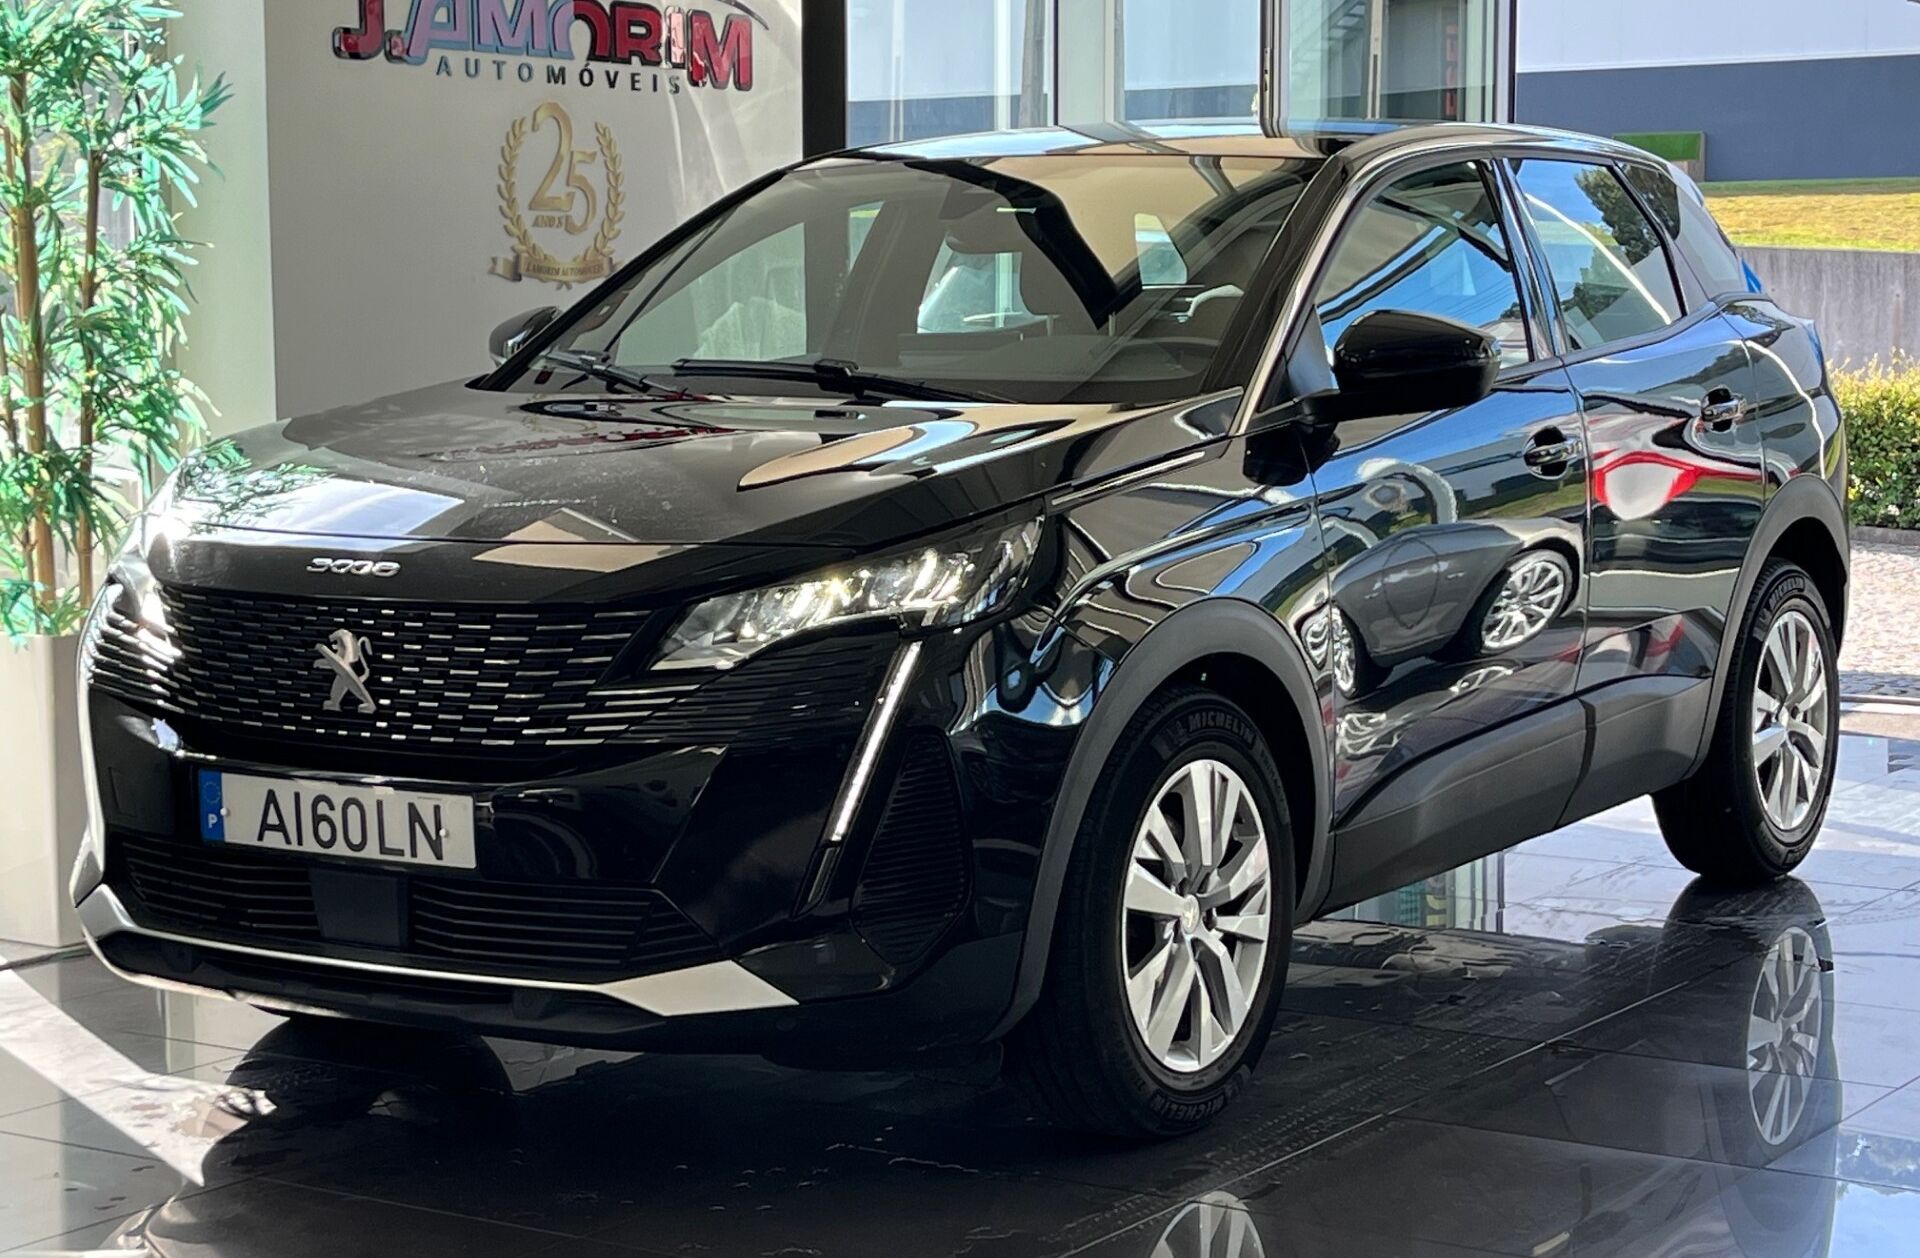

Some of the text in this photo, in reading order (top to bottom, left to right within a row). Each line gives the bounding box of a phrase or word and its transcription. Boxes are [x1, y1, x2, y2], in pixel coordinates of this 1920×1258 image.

[435, 55, 682, 95] AUTOMÓVEIS
[528, 101, 597, 236] 25
[306, 557, 401, 577] 3008
[1187, 711, 1257, 747] MICHELIN
[207, 813, 218, 829] P
